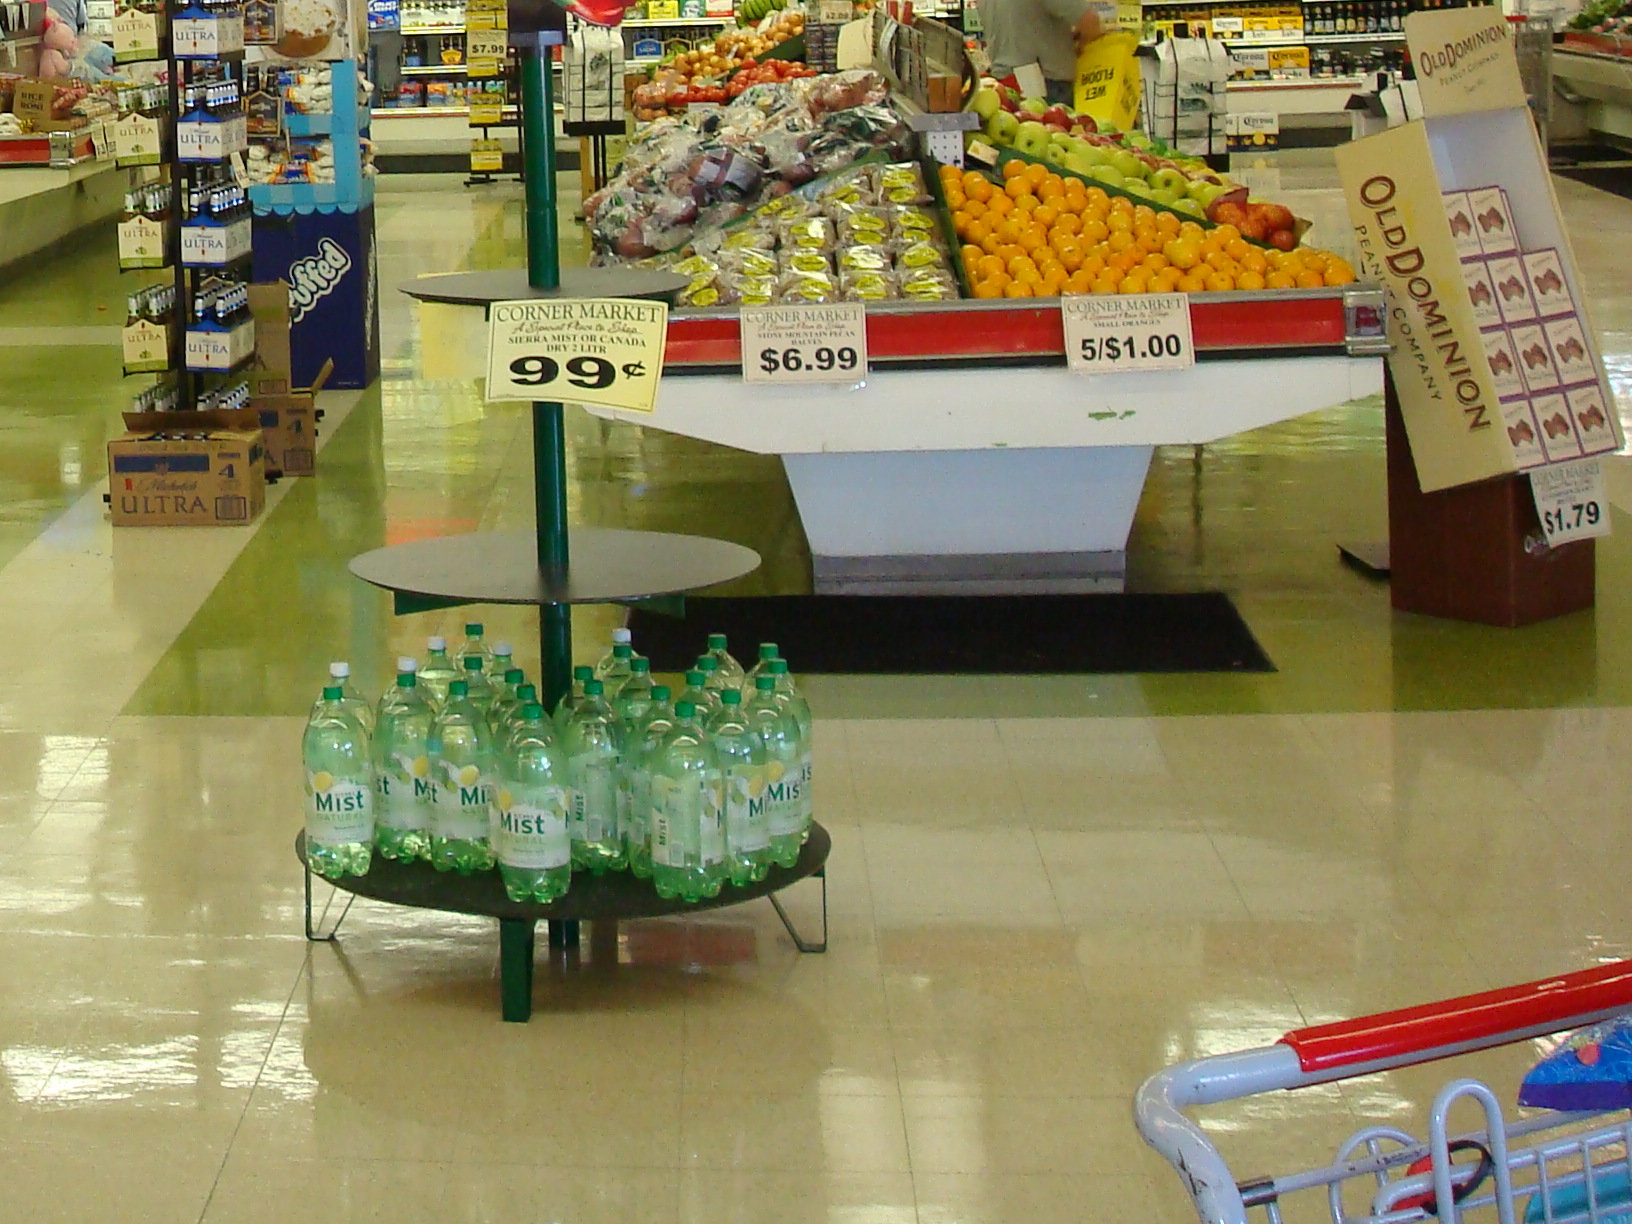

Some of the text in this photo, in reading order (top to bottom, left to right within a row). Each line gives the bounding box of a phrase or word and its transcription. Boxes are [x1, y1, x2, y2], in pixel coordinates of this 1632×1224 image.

[175, 31, 215, 42] ULTRA
[472, 44, 504, 54] $7.99
[1272, 51, 1306, 61] Corona
[1085, 85, 1107, 101] WET
[120, 126, 154, 137] ULTRA
[180, 133, 220, 144] ULTRA
[184, 238, 224, 249] ULTRA
[289, 237, 352, 324] uffed
[496, 303, 661, 323] CORNER MARKET
[1068, 298, 1183, 314] CORNER MARKET
[746, 309, 859, 323] CORNER MARKET
[508, 334, 648, 348] SIERRA MIST OR CANADA
[1385, 246, 1492, 432] DOMINION
[188, 343, 228, 354] ULTRA
[546, 344, 607, 355] DRY 2 LITR
[1081, 334, 1182, 362] 5/$1.00
[1392, 307, 1442, 400] COMPANY
[760, 346, 858, 374] $6.99
[121, 495, 209, 515] ULTRA
[1544, 501, 1600, 535] $1.79
[315, 790, 365, 812] Mist
[500, 810, 546, 835] Mist
